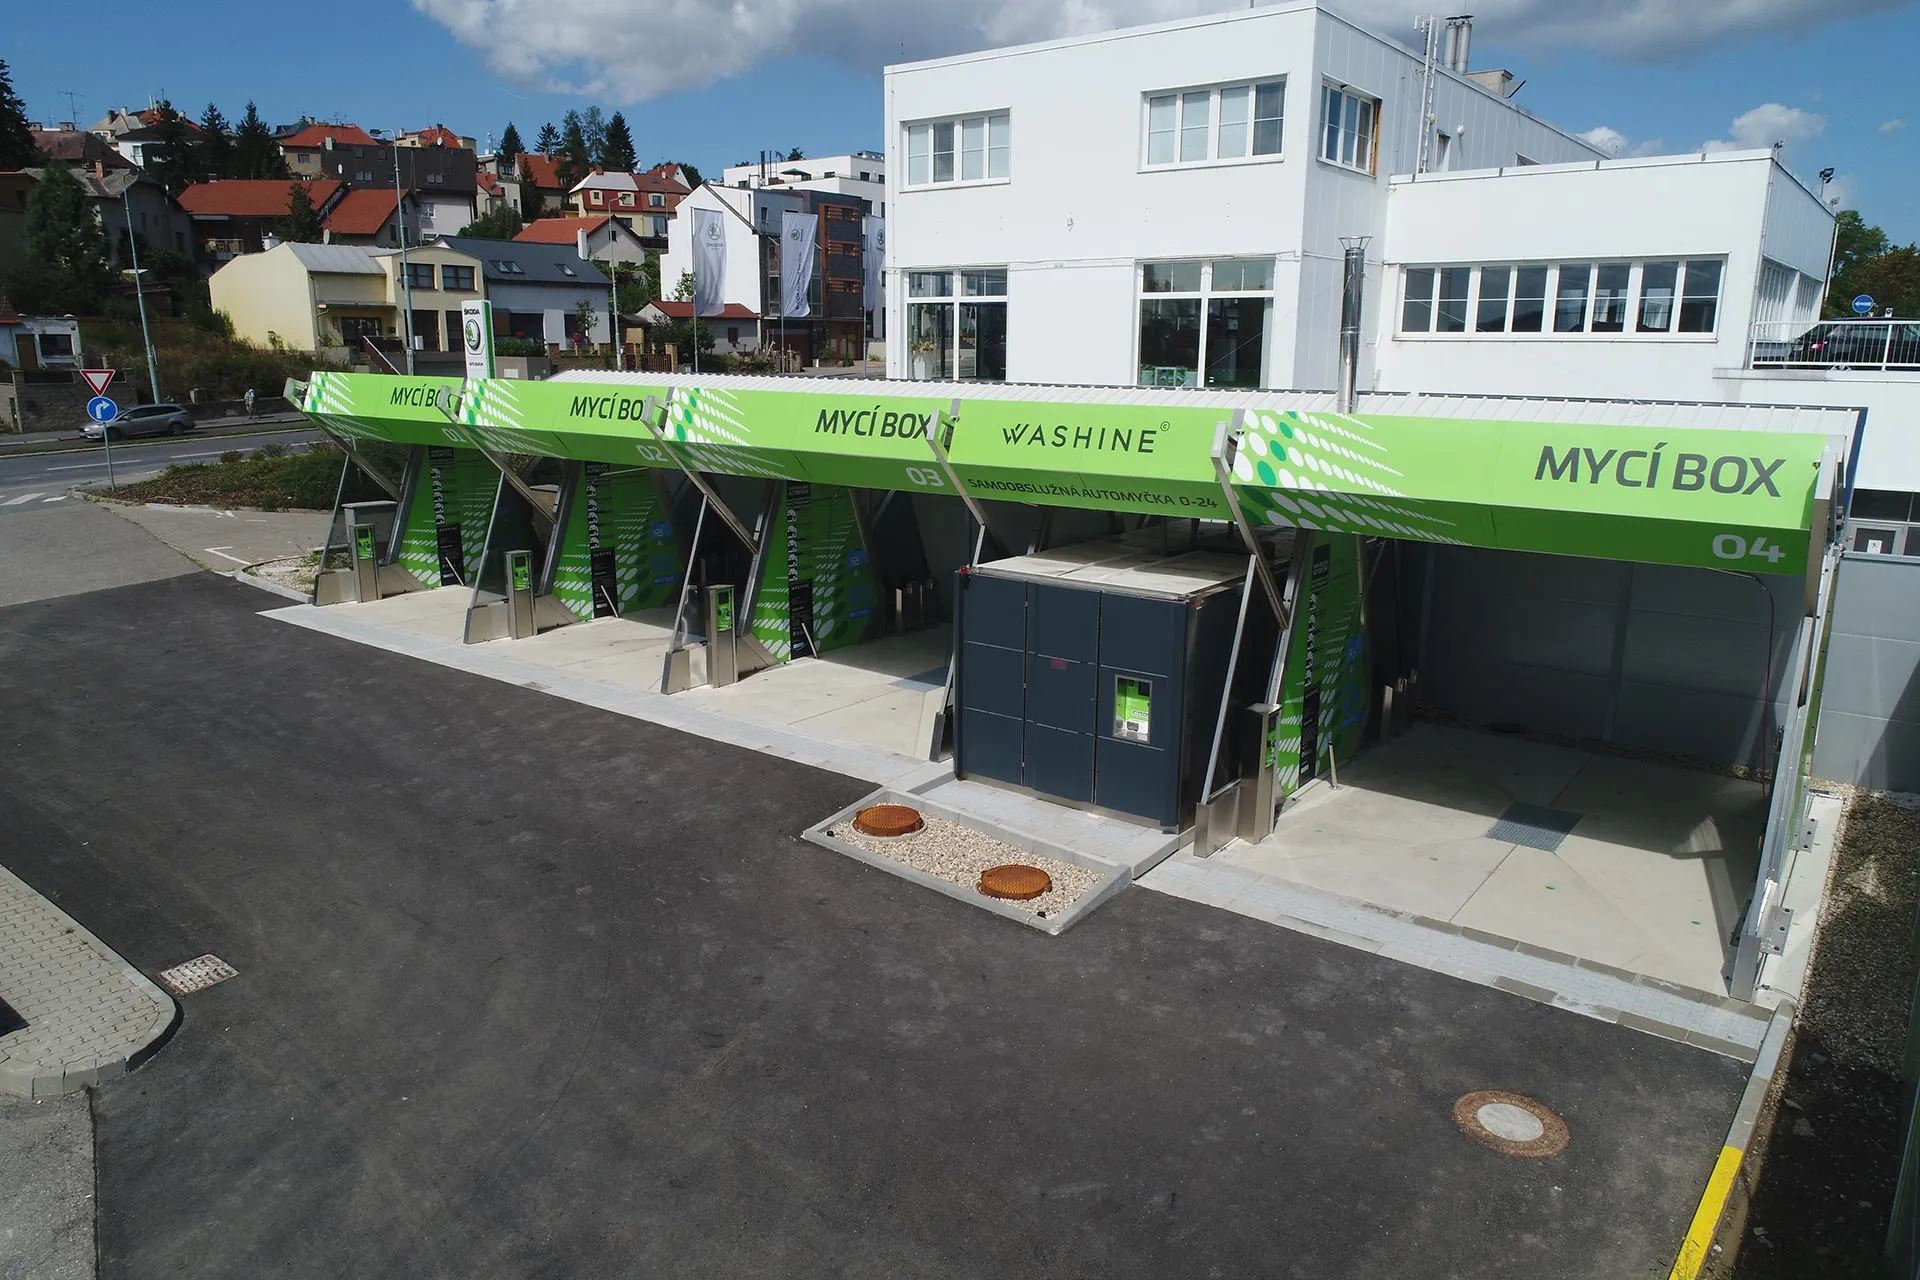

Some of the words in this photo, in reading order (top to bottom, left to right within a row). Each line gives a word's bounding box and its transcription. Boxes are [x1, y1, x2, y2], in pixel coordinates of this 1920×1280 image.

[390, 383, 427, 407] MYCÍ
[569, 392, 619, 419] MYCÍ
[617, 398, 646, 421] BO
[815, 405, 881, 437] MYCÍ
[880, 412, 932, 439] BOX
[635, 444, 669, 462] 02
[1002, 423, 1157, 453] WASHINE
[905, 466, 945, 486] 03
[1534, 442, 1668, 489] MYCÍ
[1672, 453, 1787, 498] BOX
[967, 478, 1081, 498] SAMOOBSLUŽNÁ
[1082, 488, 1175, 506] AUTOMYČKA
[1179, 496, 1218, 509] 0-24
[1711, 533, 1786, 563] 04
